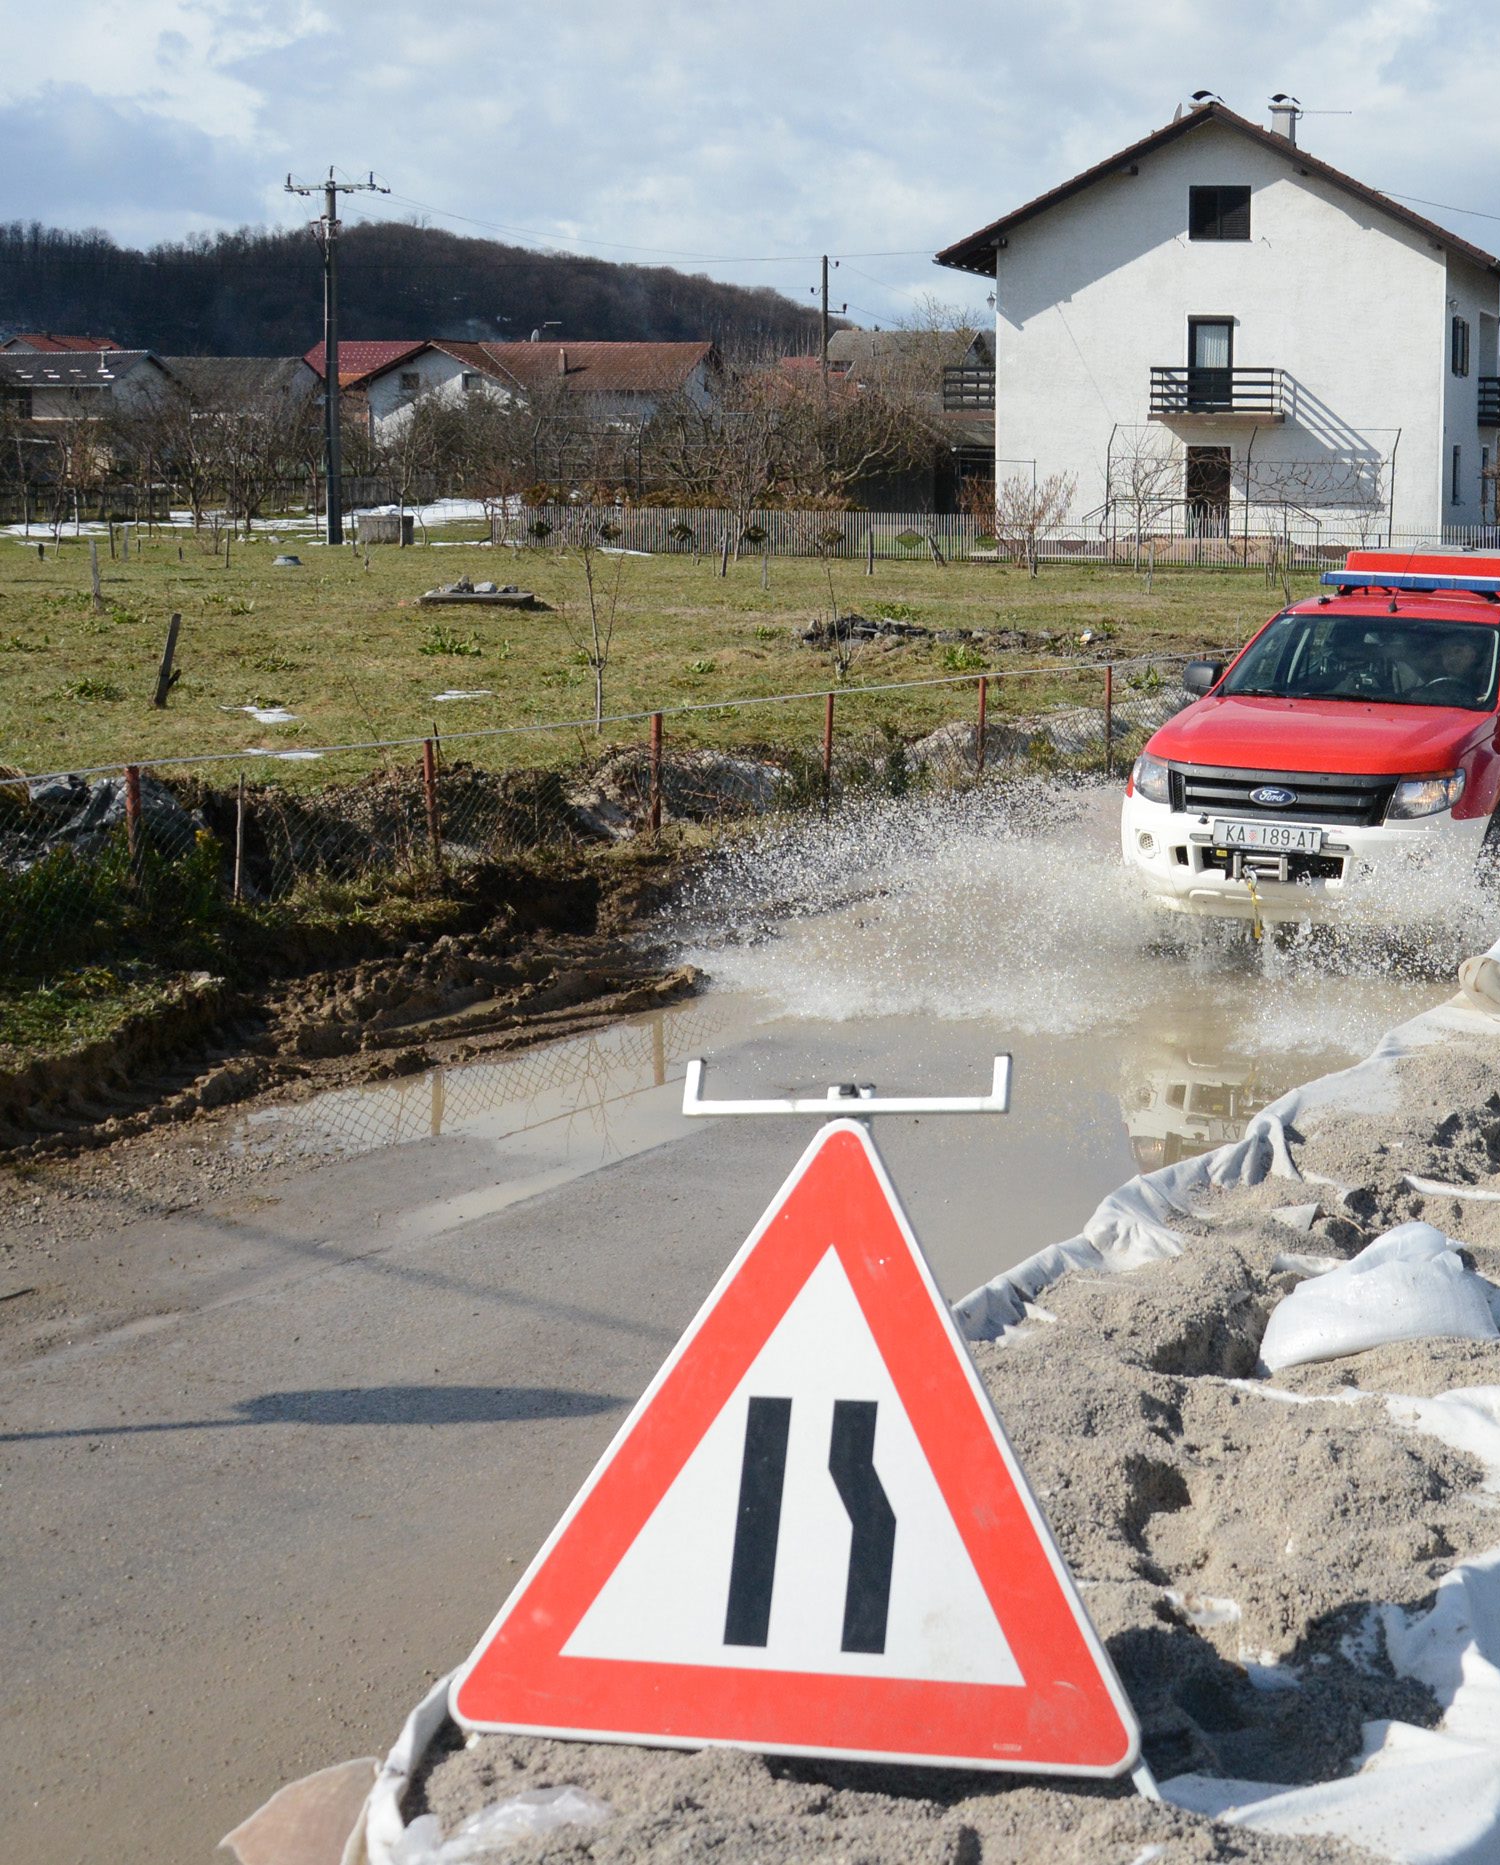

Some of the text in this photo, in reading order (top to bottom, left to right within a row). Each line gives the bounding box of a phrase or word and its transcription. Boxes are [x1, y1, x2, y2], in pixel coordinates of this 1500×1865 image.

[1259, 789, 1285, 802] Ford
[1226, 825, 1317, 849] KA 189-AT
